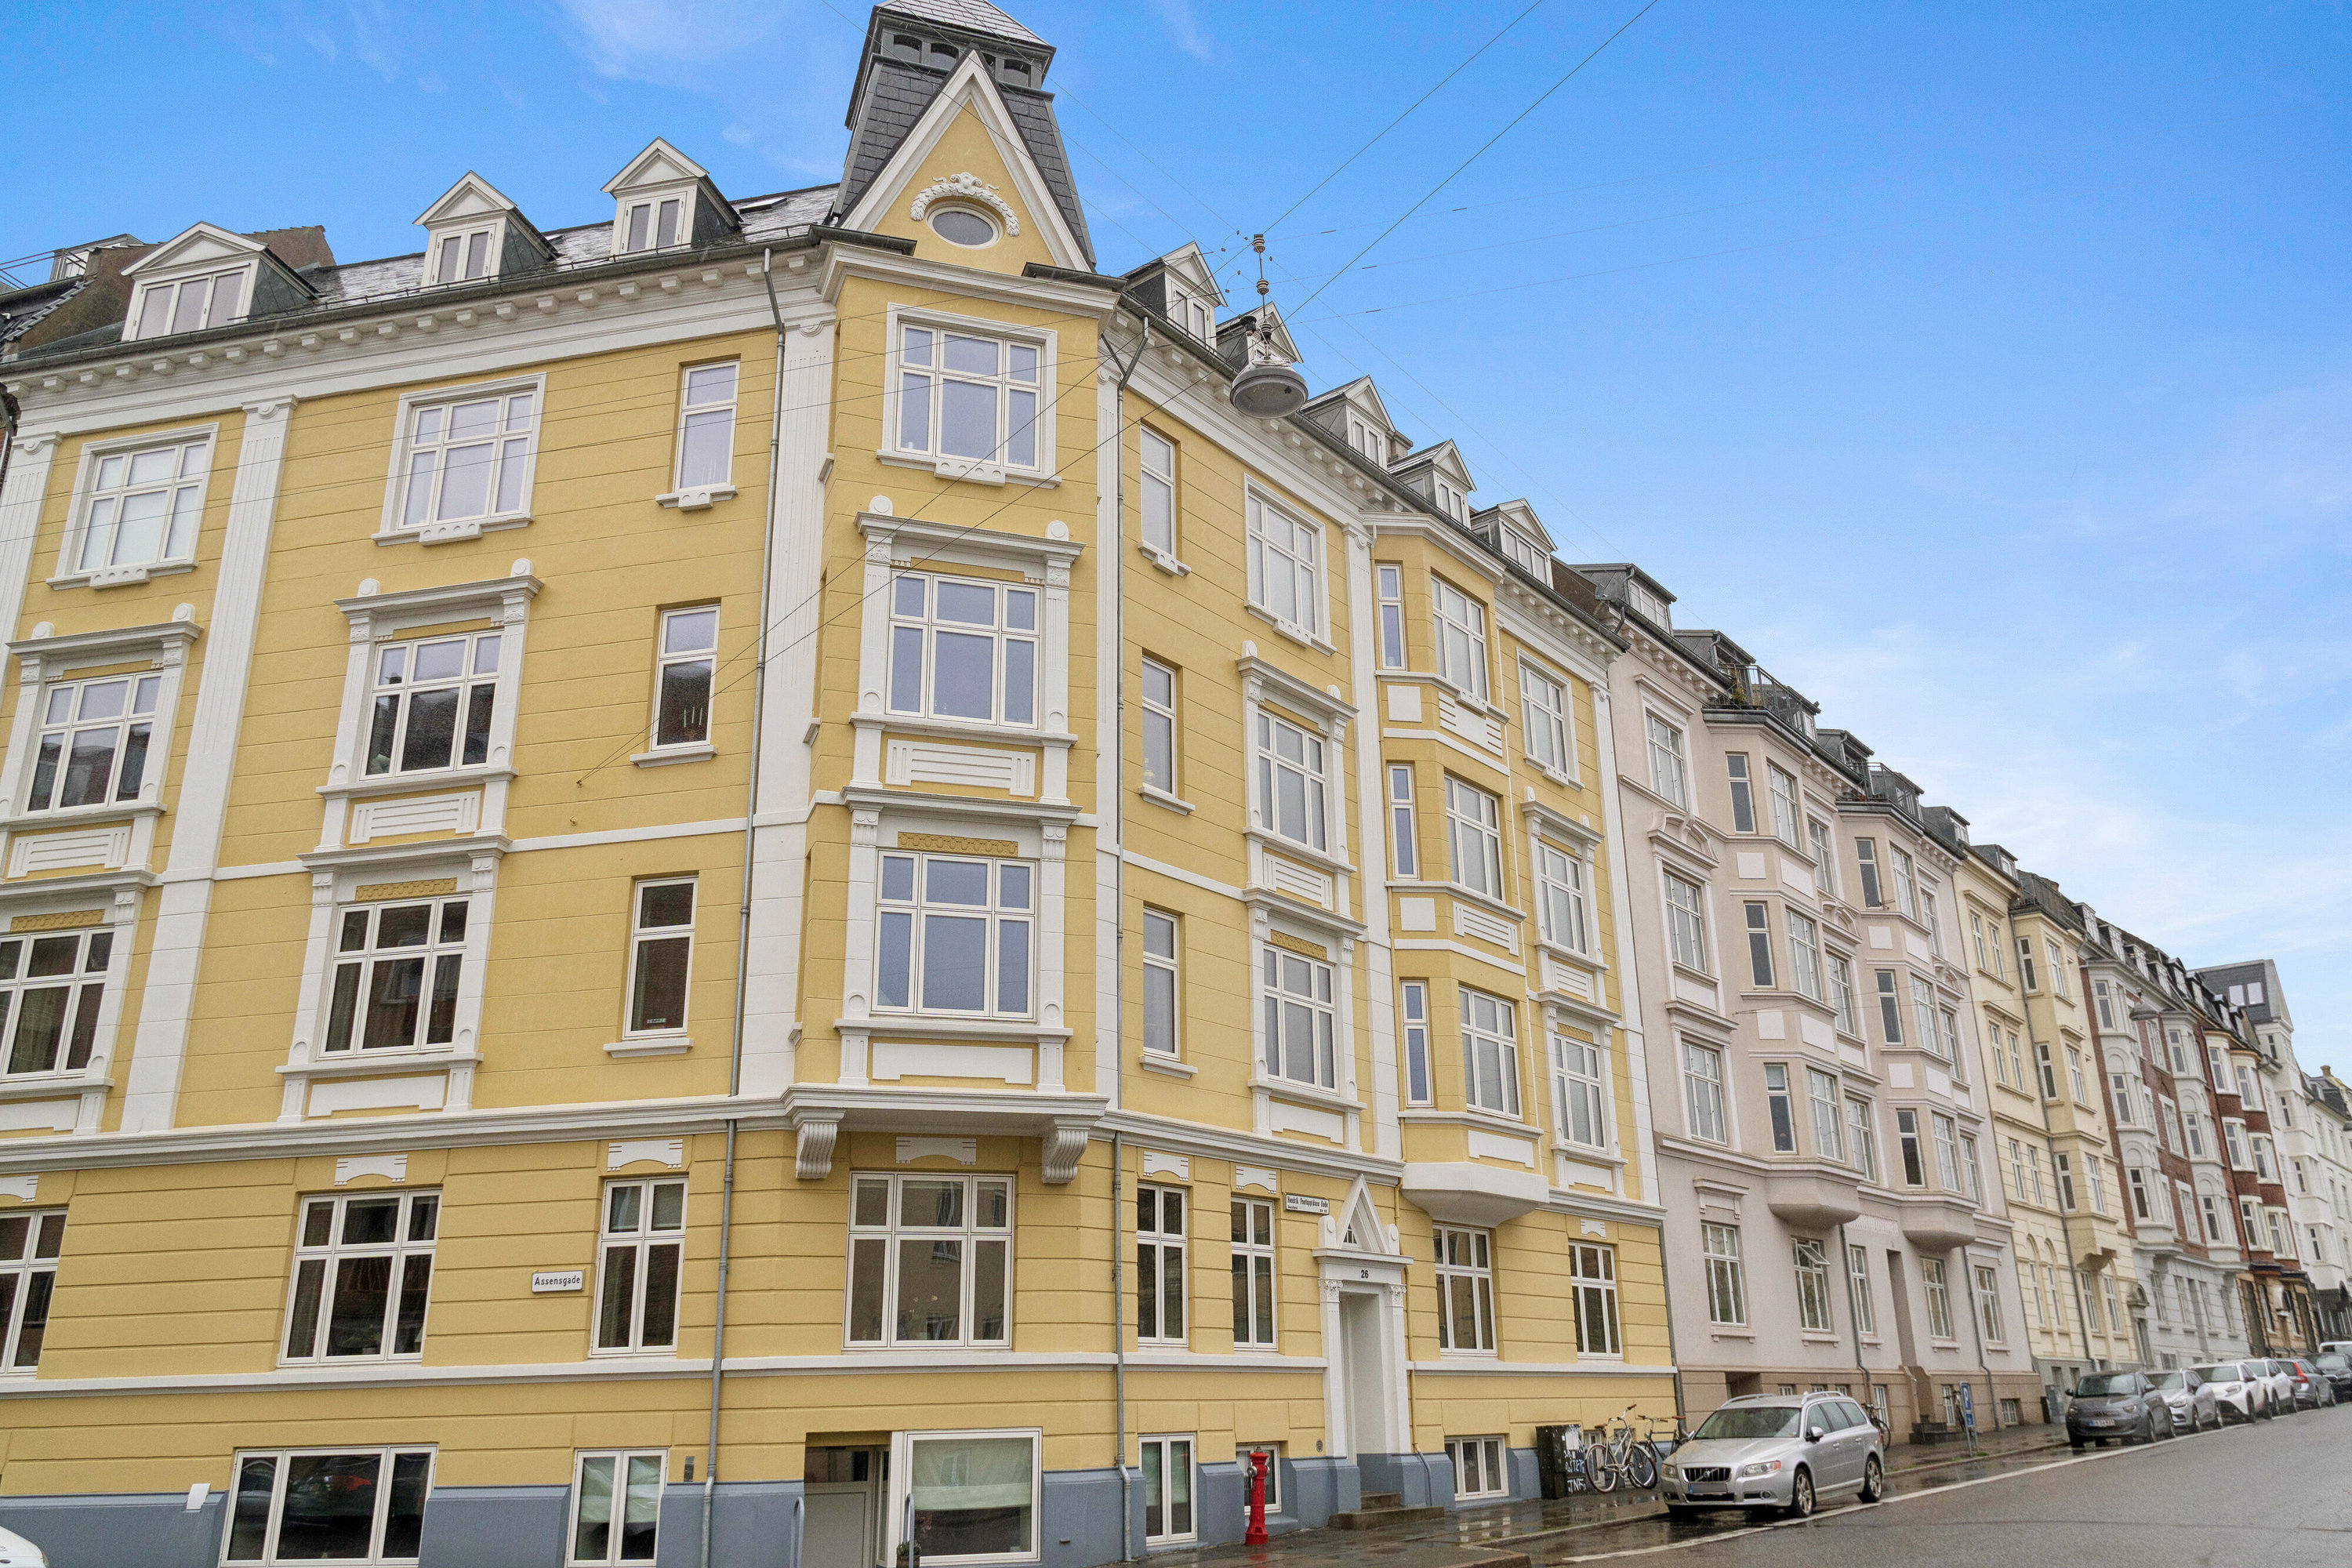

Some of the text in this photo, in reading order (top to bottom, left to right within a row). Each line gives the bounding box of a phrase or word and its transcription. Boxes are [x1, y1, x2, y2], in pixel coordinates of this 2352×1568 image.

[1360, 1269, 1369, 1279] 26
[534, 1275, 581, 1287] Assensgade
[1963, 1387, 1969, 1409] P
